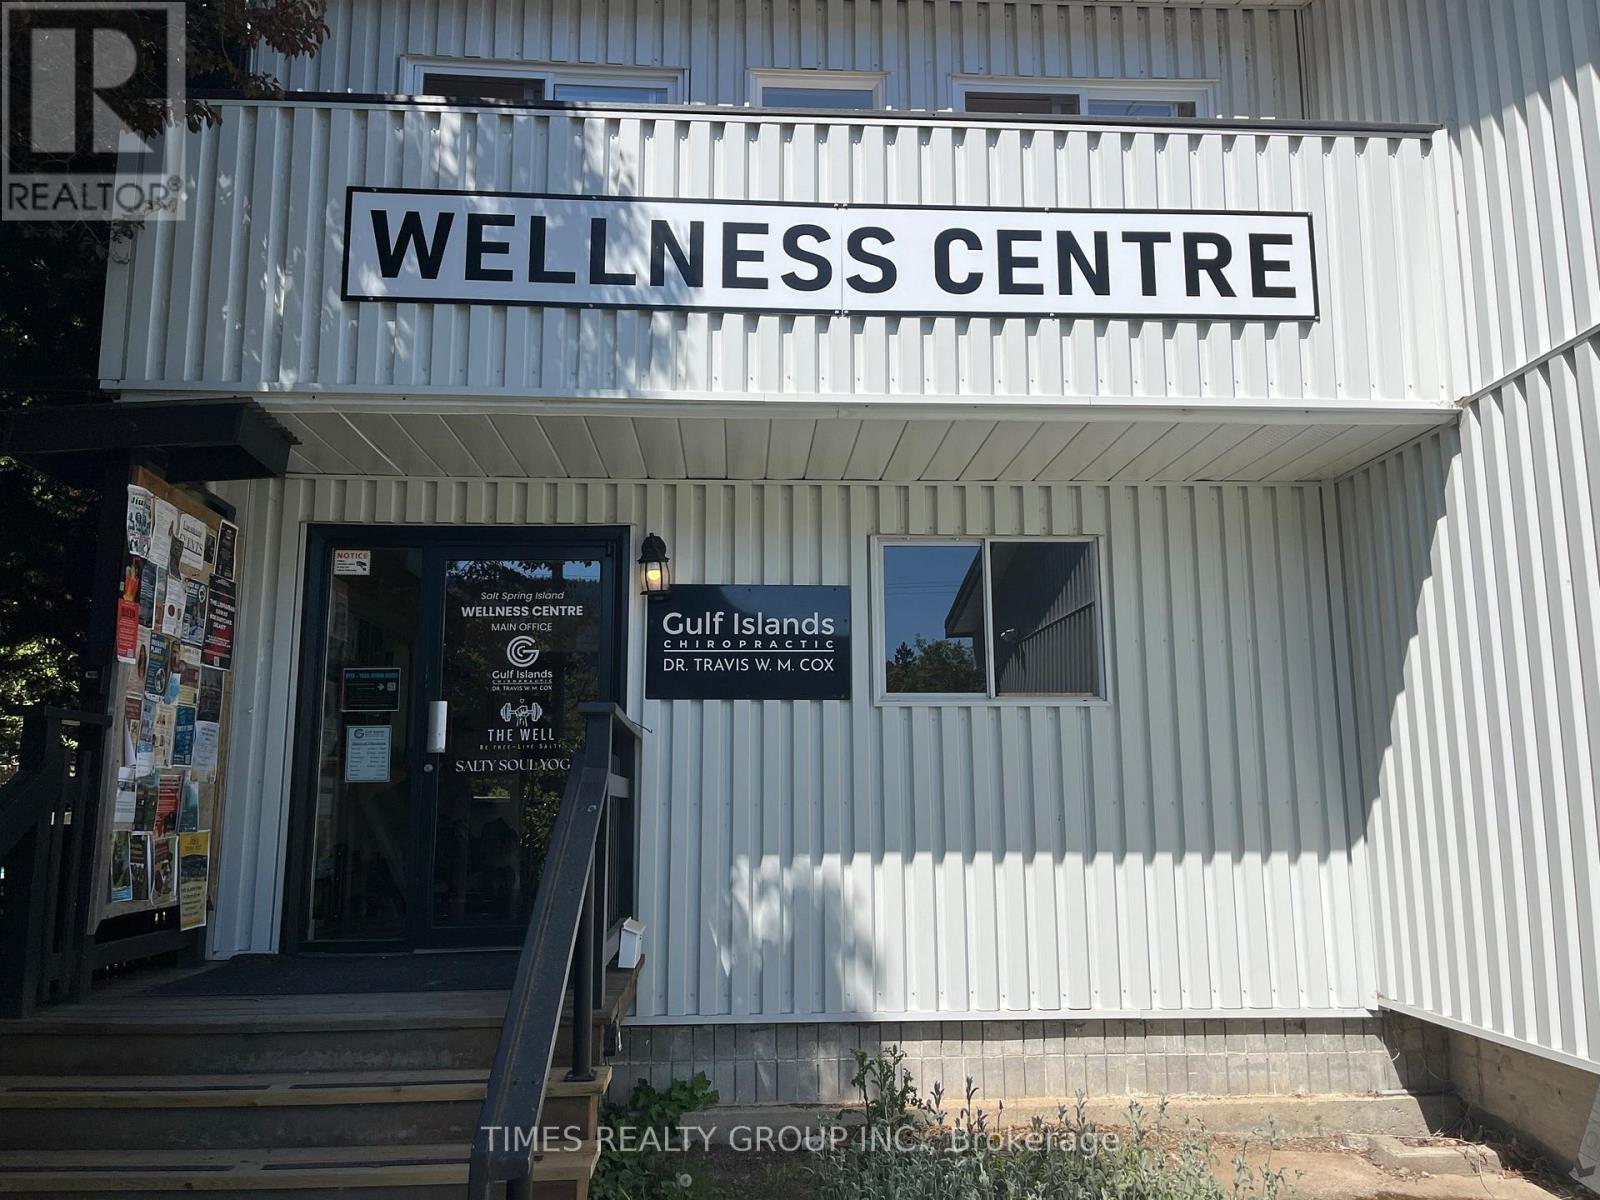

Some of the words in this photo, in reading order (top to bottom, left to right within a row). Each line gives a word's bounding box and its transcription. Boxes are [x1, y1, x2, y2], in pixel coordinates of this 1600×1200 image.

[370, 209, 898, 294] WELLNESS
[933, 227, 1297, 299] CENTRE
[481, 591, 499, 600] Salt
[502, 591, 533, 602] Spring
[535, 591, 565, 600] Island
[461, 606, 530, 617] WELLNESS
[532, 605, 584, 616] CENTRE
[491, 623, 517, 632] MAIN
[519, 622, 553, 632] OFFICE
[662, 611, 725, 636] Gulf
[734, 611, 835, 636] Islands
[663, 639, 835, 649] CHIROPRACTIC
[663, 658, 689, 672] DR.
[694, 658, 750, 672] TRAVIS
[754, 658, 772, 672] W.
[777, 658, 795, 672] M.
[800, 658, 835, 672] COX
[492, 670, 513, 679] Gulf
[516, 669, 553, 679] Islands
[487, 729, 513, 742] THE
[520, 728, 555, 741] WELL
[455, 760, 496, 772] SALTY
[498, 759, 537, 771] SOUL
[540, 758, 571, 771] YOG
